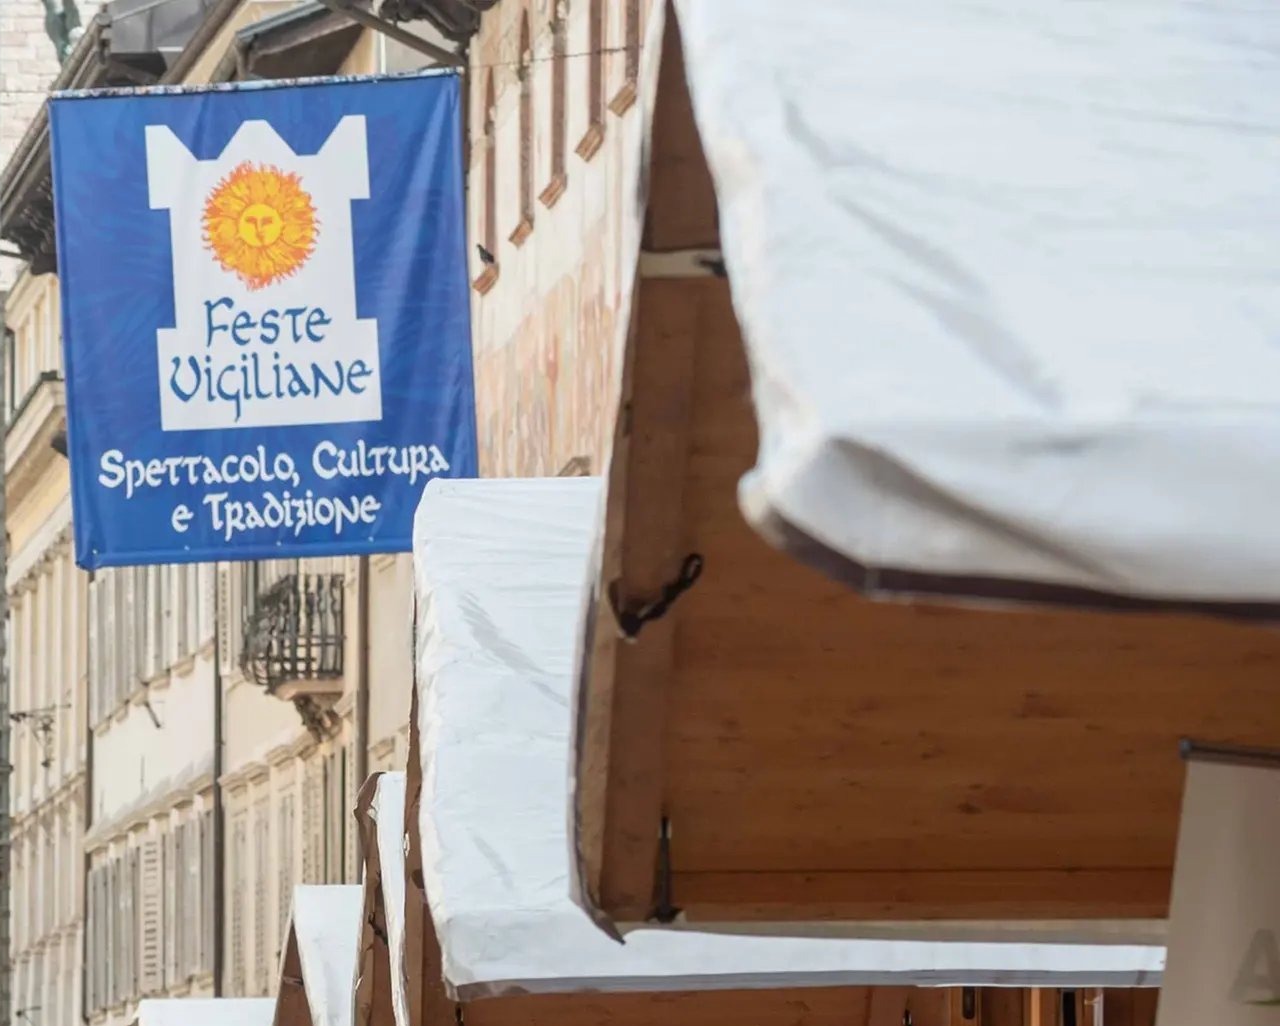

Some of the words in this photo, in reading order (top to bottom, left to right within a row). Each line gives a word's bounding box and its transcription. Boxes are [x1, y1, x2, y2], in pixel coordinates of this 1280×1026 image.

[204, 297, 332, 347] Feste
[169, 350, 374, 423] Vigiliane
[98, 445, 300, 499] Spettacolo,
[311, 438, 451, 486] Cultura
[171, 510, 195, 533] e
[202, 490, 382, 543] Tradizione
